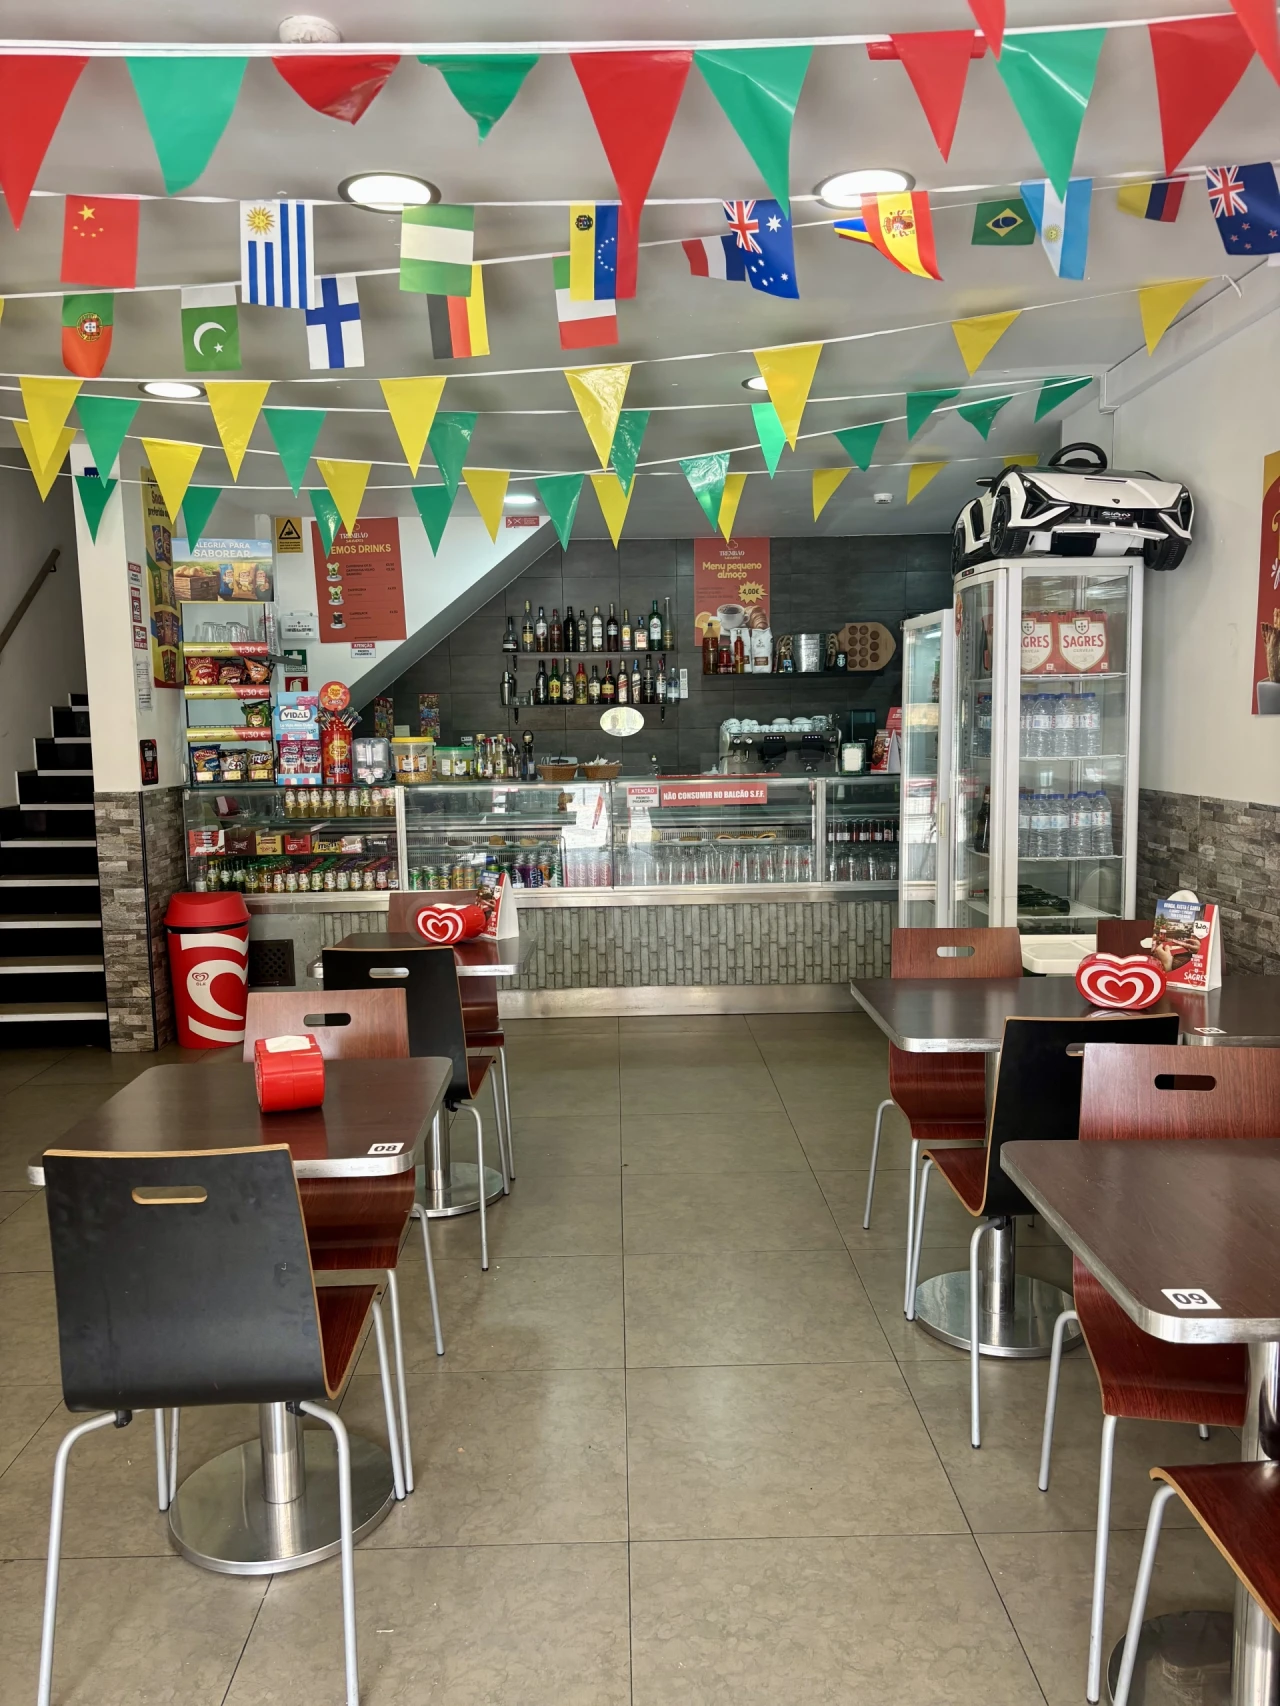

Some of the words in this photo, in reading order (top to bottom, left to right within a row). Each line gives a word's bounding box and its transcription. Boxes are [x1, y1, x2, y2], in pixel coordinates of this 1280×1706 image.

[194, 549, 250, 557] SABOREAR
[331, 545, 356, 555] EMOS
[358, 544, 391, 553] DRINKS
[702, 562, 725, 570] Menu
[727, 563, 762, 572] pequeno
[717, 570, 747, 580] almoço
[1021, 635, 1050, 648] GRES
[1062, 634, 1104, 648] SAGRES
[239, 646, 256, 654] 1,30
[240, 688, 257, 696] 1,30
[284, 711, 308, 719] VIDAL
[663, 791, 676, 800] NÃO
[678, 791, 713, 800] CONSUMIR
[724, 790, 749, 799] BALCÃO
[750, 790, 765, 798] S.F.F.
[1184, 971, 1208, 982] SAGRES
[1172, 1293, 1208, 1305] 09
